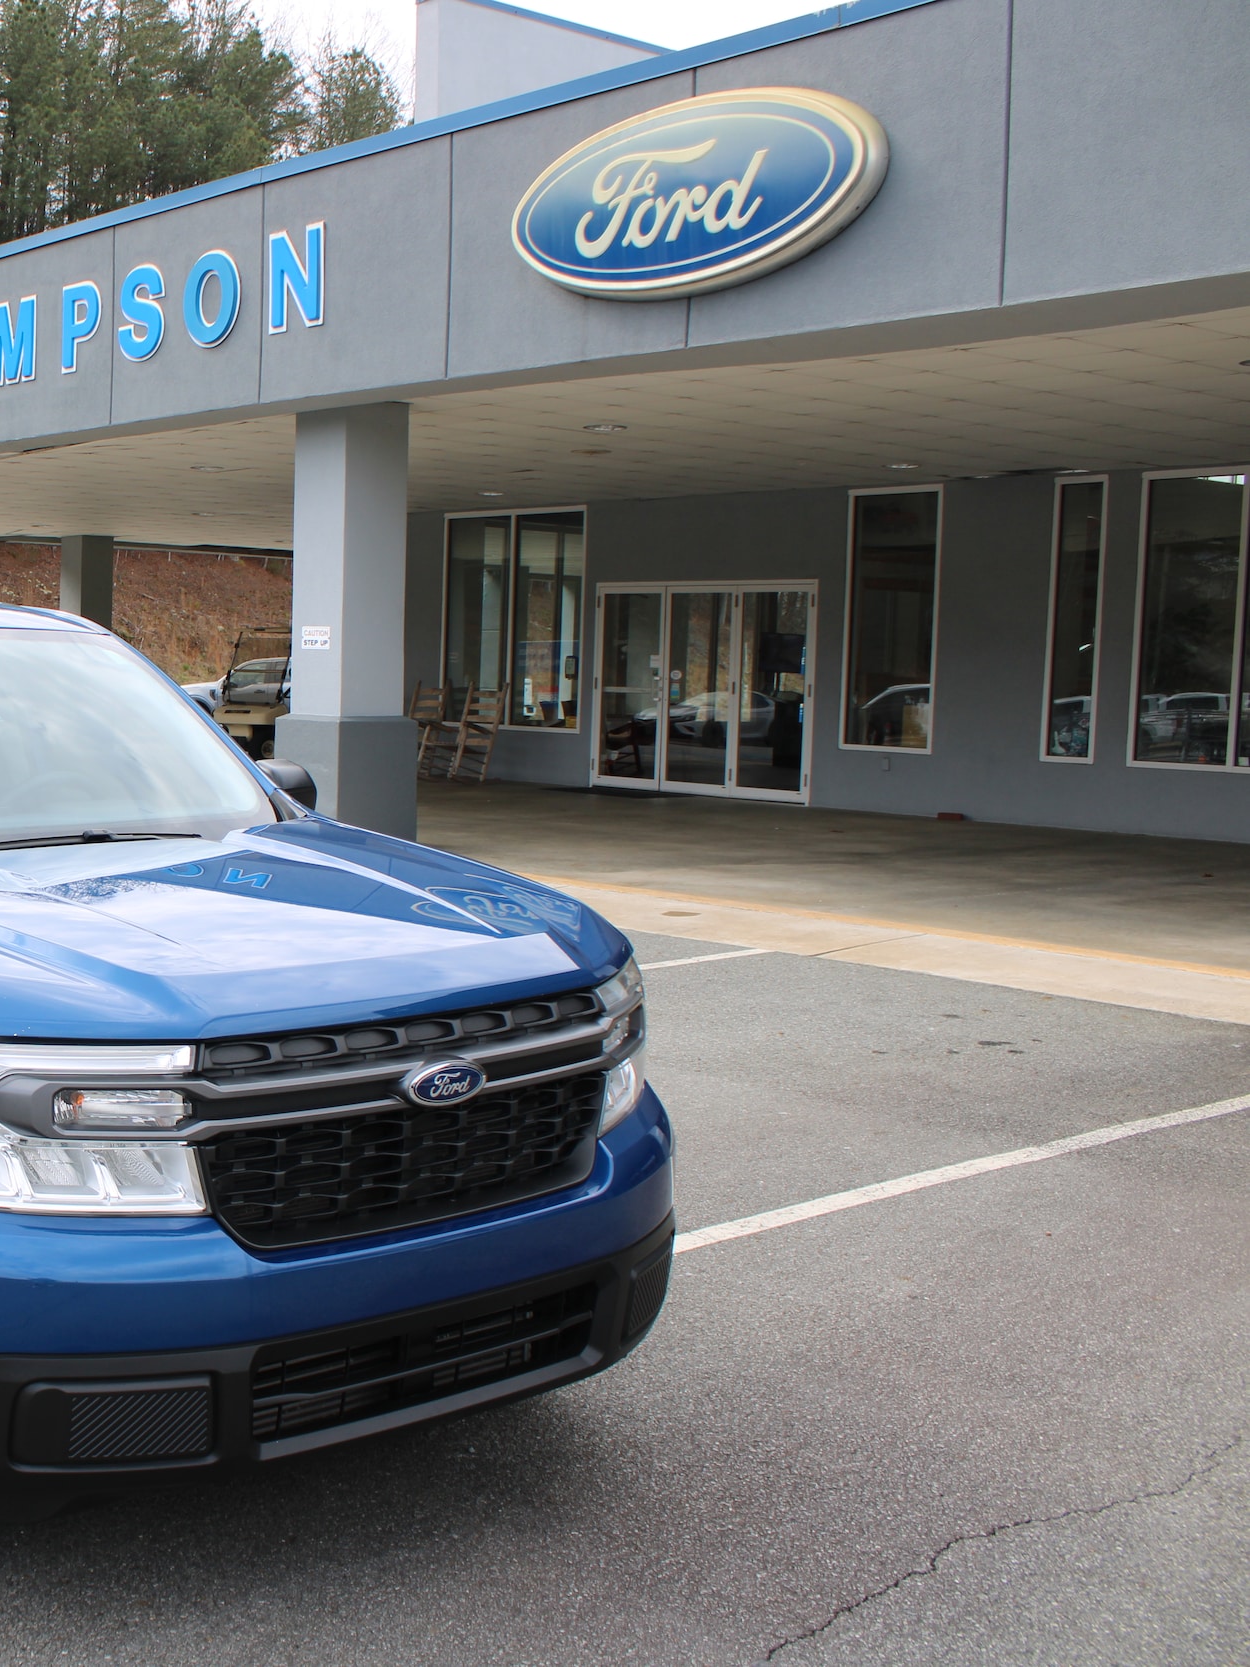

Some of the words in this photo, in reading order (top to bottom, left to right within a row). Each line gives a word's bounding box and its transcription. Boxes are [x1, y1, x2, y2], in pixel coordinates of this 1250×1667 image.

[575, 137, 769, 259] Ford
[303, 629, 329, 637] CAUTION
[429, 1071, 471, 1099] Ford
